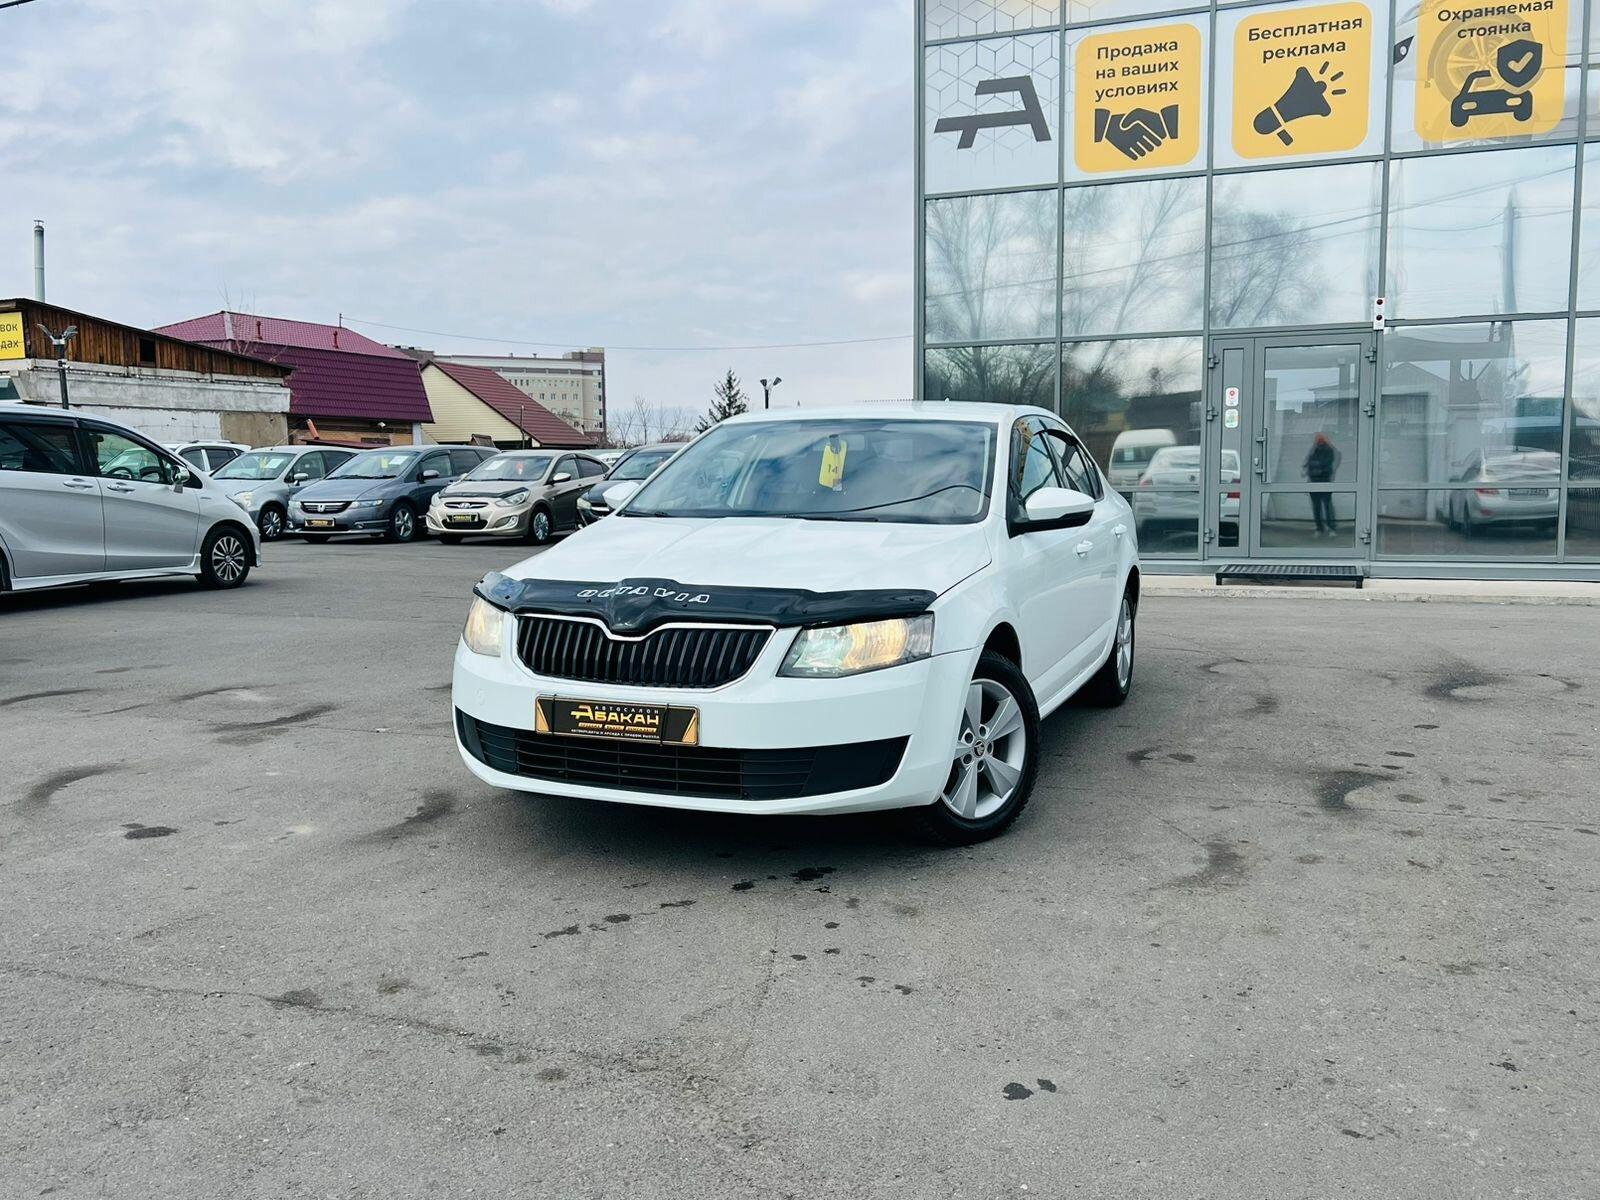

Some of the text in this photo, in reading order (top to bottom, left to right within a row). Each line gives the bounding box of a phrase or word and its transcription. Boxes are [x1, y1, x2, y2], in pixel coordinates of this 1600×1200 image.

[1437, 0, 1554, 22] Охраняемая
[1248, 18, 1363, 41] Бесплатная
[1457, 22, 1531, 39] стоянка
[1097, 41, 1178, 61] Продажа
[1263, 41, 1346, 64] реклама
[1096, 61, 1179, 79] на ваших
[1095, 81, 1179, 102] условиях
[594, 705, 659, 715] АВТОСАЛОН
